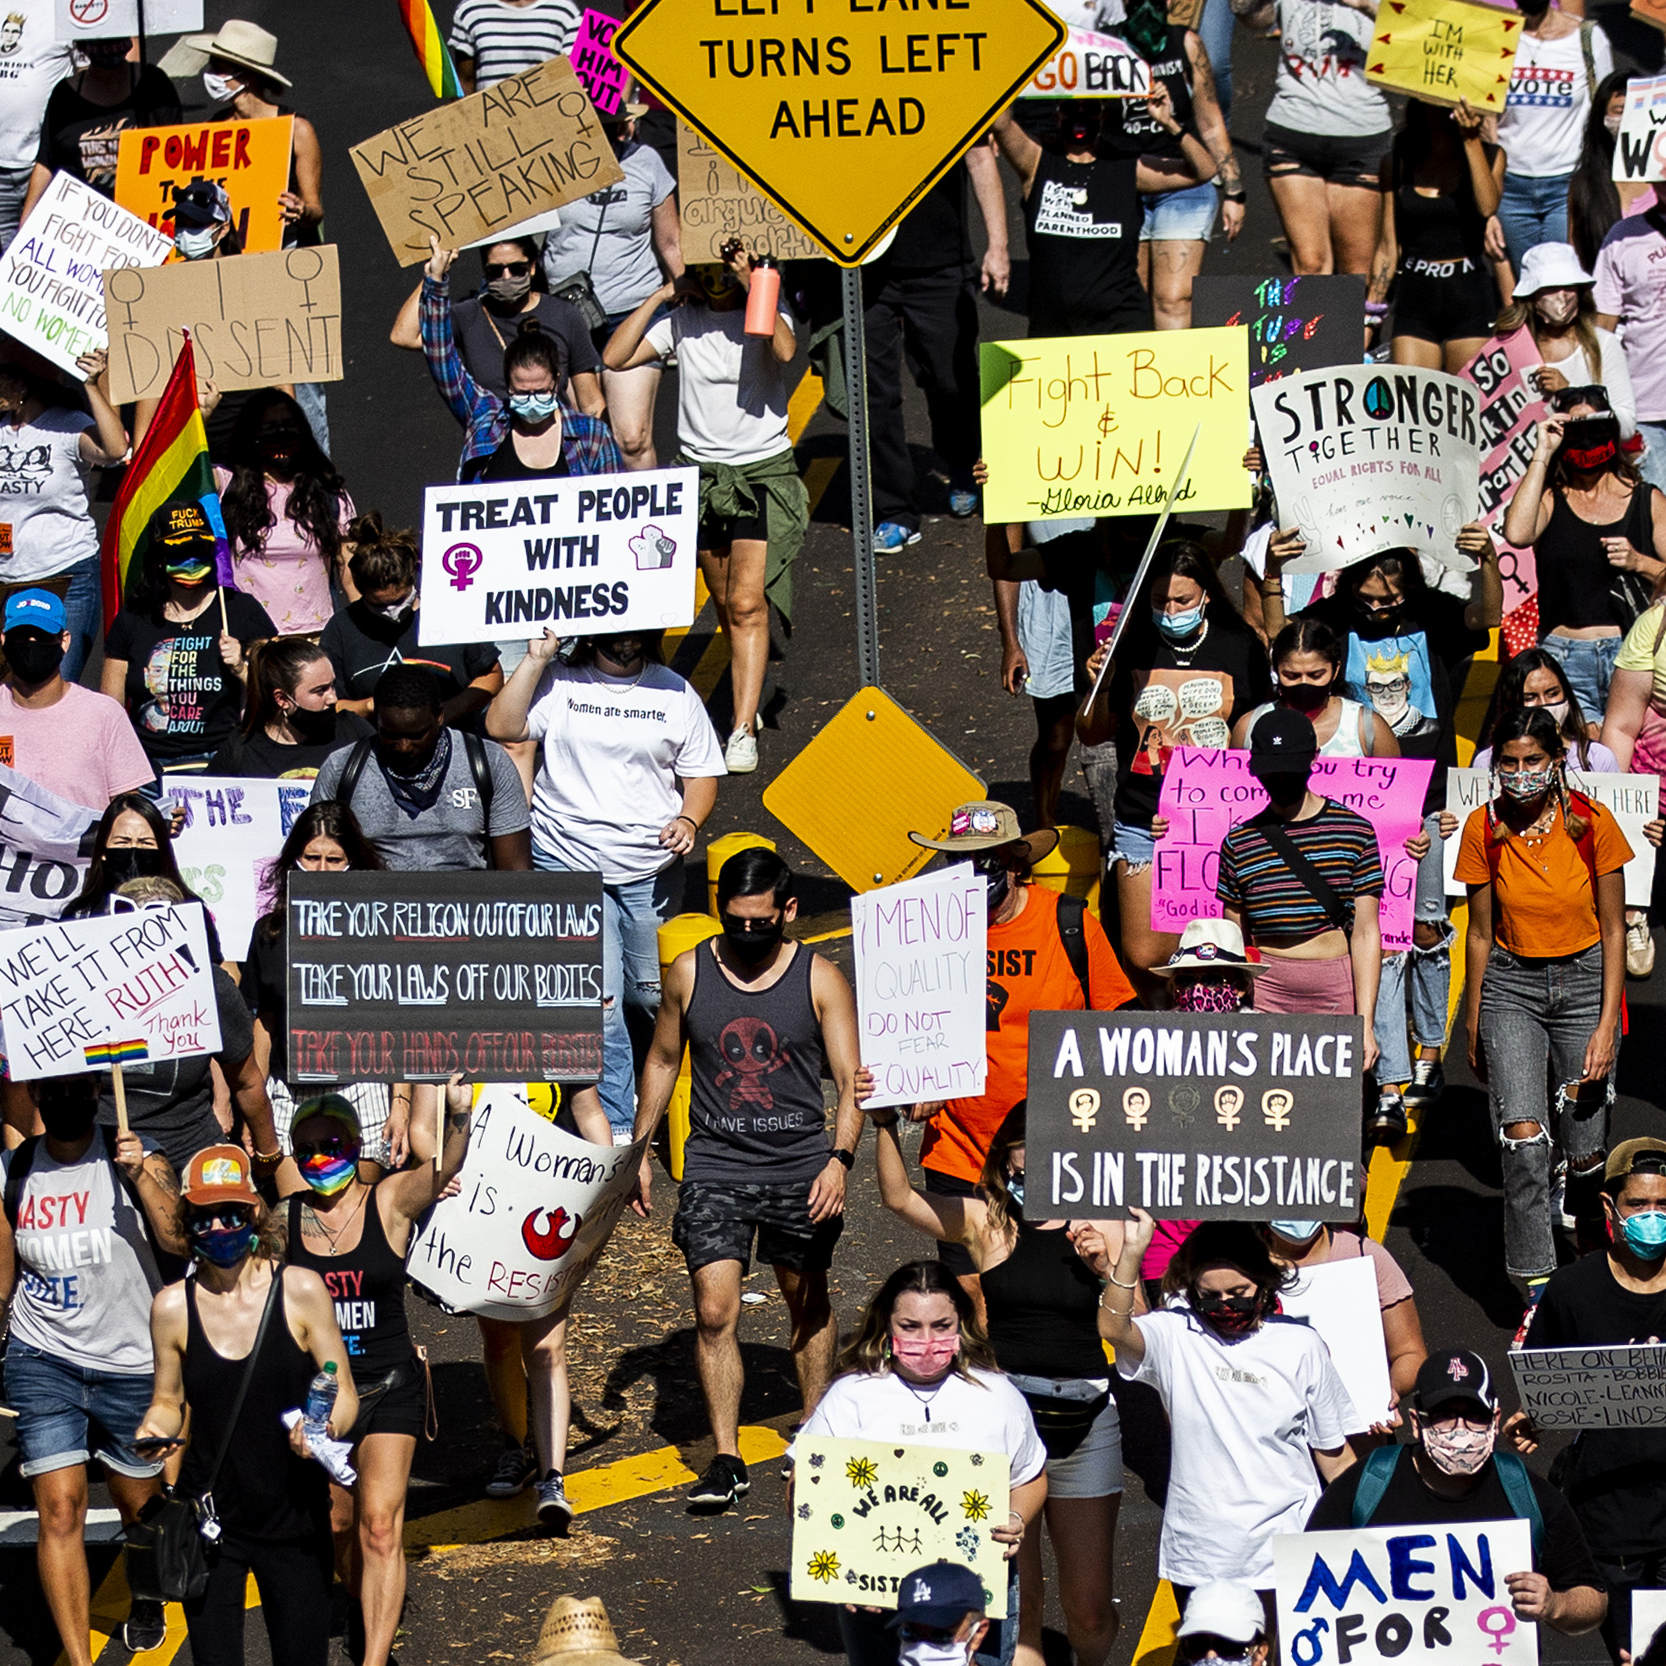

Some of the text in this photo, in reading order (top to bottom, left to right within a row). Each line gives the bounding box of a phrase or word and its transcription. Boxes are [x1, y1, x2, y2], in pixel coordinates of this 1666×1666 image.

[699, 32, 988, 78] TURNS LEFT
[1034, 49, 1147, 91] GO BACK
[1507, 74, 1573, 98] VOTE
[355, 63, 560, 177] WE ARE
[770, 97, 925, 140] AHEAD
[139, 129, 252, 174] POWER
[407, 134, 557, 199] STILL
[405, 141, 603, 249] SPEAKING
[1006, 346, 1235, 428] Fight Back
[169, 518, 204, 528] TRUMP
[171, 508, 199, 519] FUCK
[436, 483, 684, 533] TREAT PEOPLE
[524, 536, 600, 572] WITH
[484, 582, 629, 625] KINDNESS
[172, 651, 197, 664] FOR
[174, 637, 212, 651] FIGHT
[169, 678, 222, 691] THINGS
[171, 664, 197, 677] THE
[169, 706, 204, 719] CARE
[170, 692, 197, 705] YOU
[3, 907, 187, 1028] TAKE IT FROM
[23, 943, 200, 1066] HERE, RUTH!
[142, 1000, 212, 1034] Thank
[1052, 1027, 1353, 1079] A WOMAN'S PLACE
[1051, 1151, 1354, 1207] IS IN THE RESISTANCE
[1291, 1531, 1495, 1615] MEN
[1336, 1605, 1450, 1664] FOR
